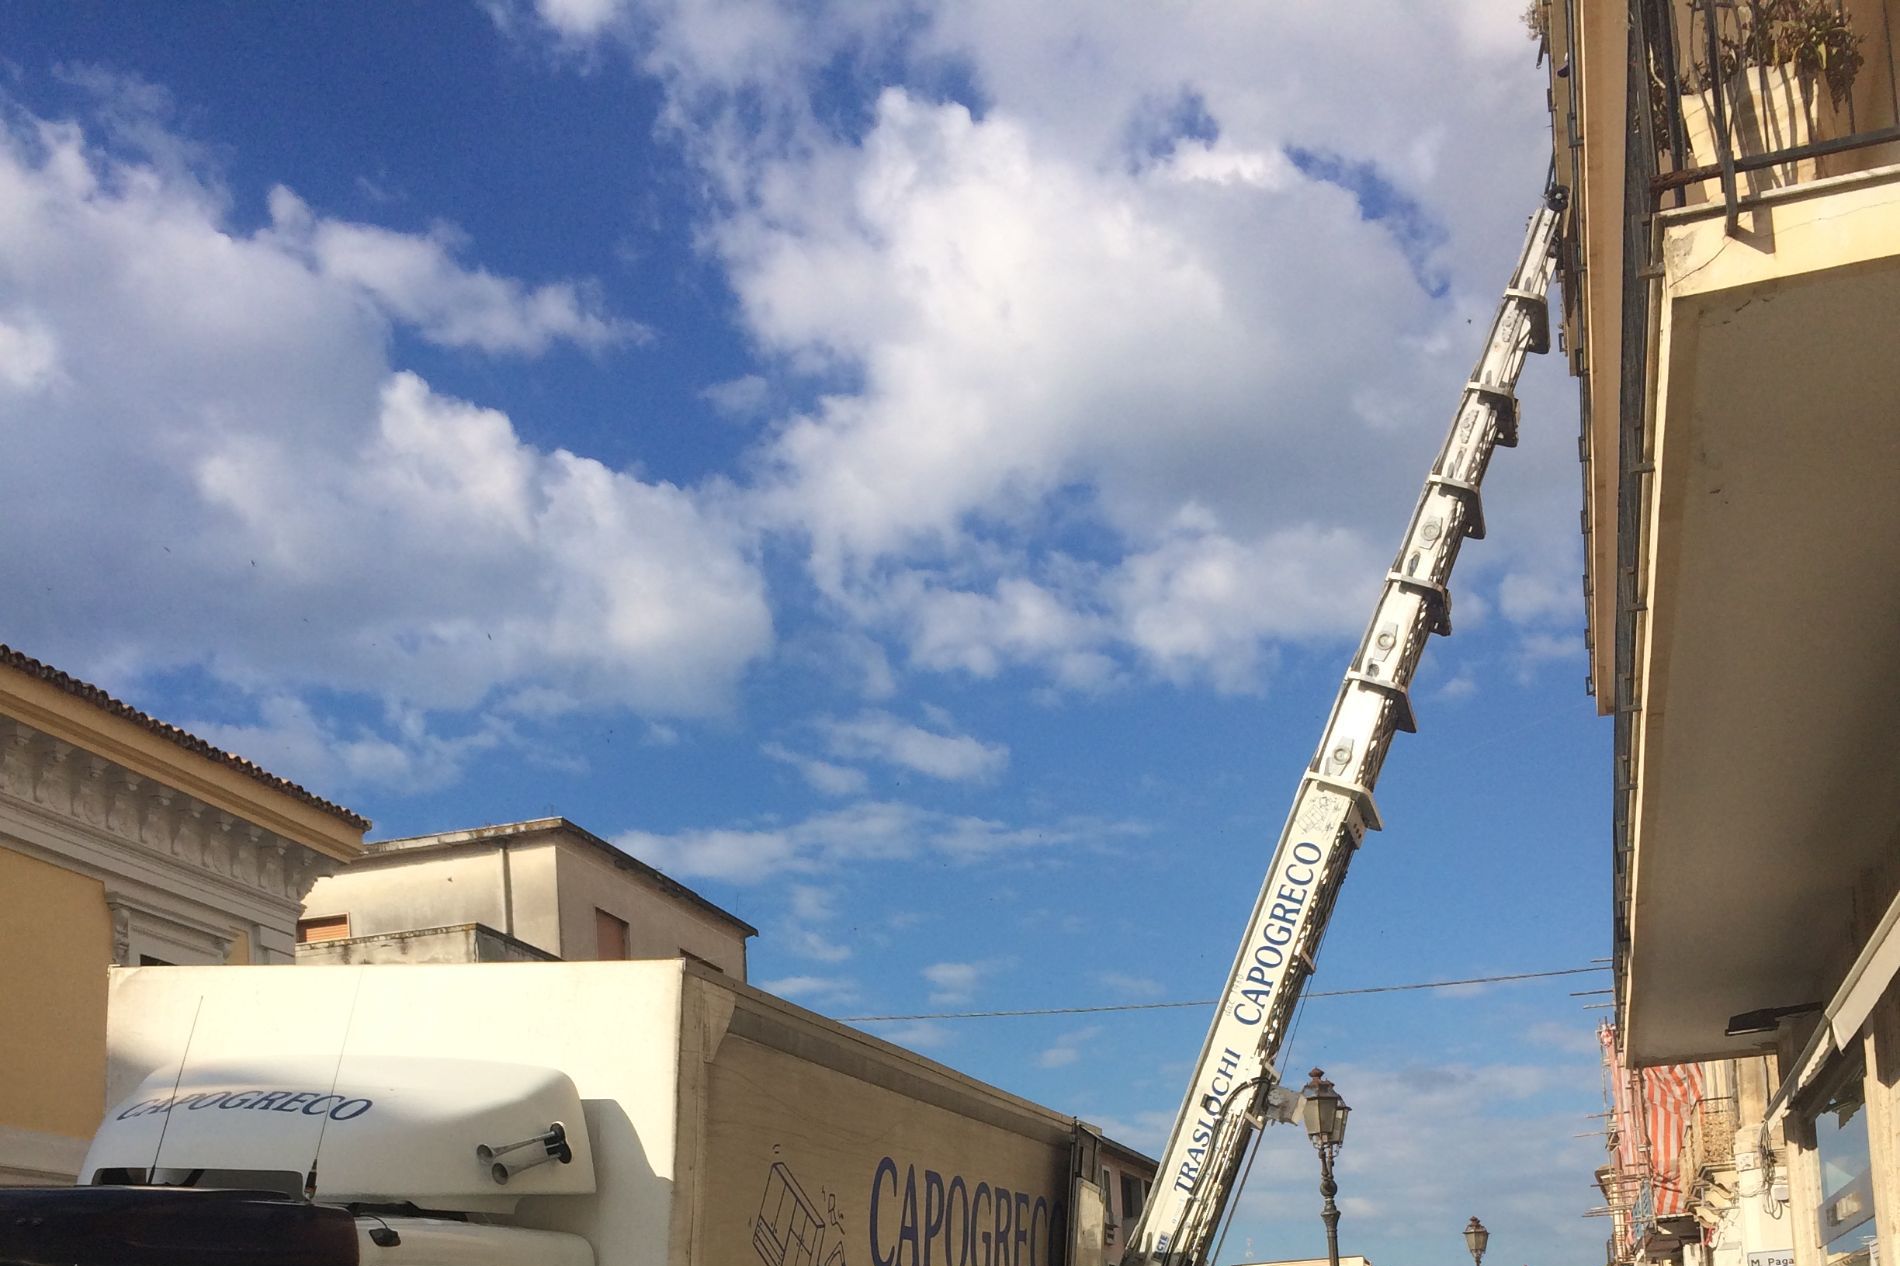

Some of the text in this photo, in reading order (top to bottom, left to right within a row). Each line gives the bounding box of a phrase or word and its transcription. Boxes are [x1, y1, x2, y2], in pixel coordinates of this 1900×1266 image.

[116, 1090, 373, 1121] CAPOGRECO
[1174, 842, 1321, 1195] TRASLOCHI CAPOGRECO
